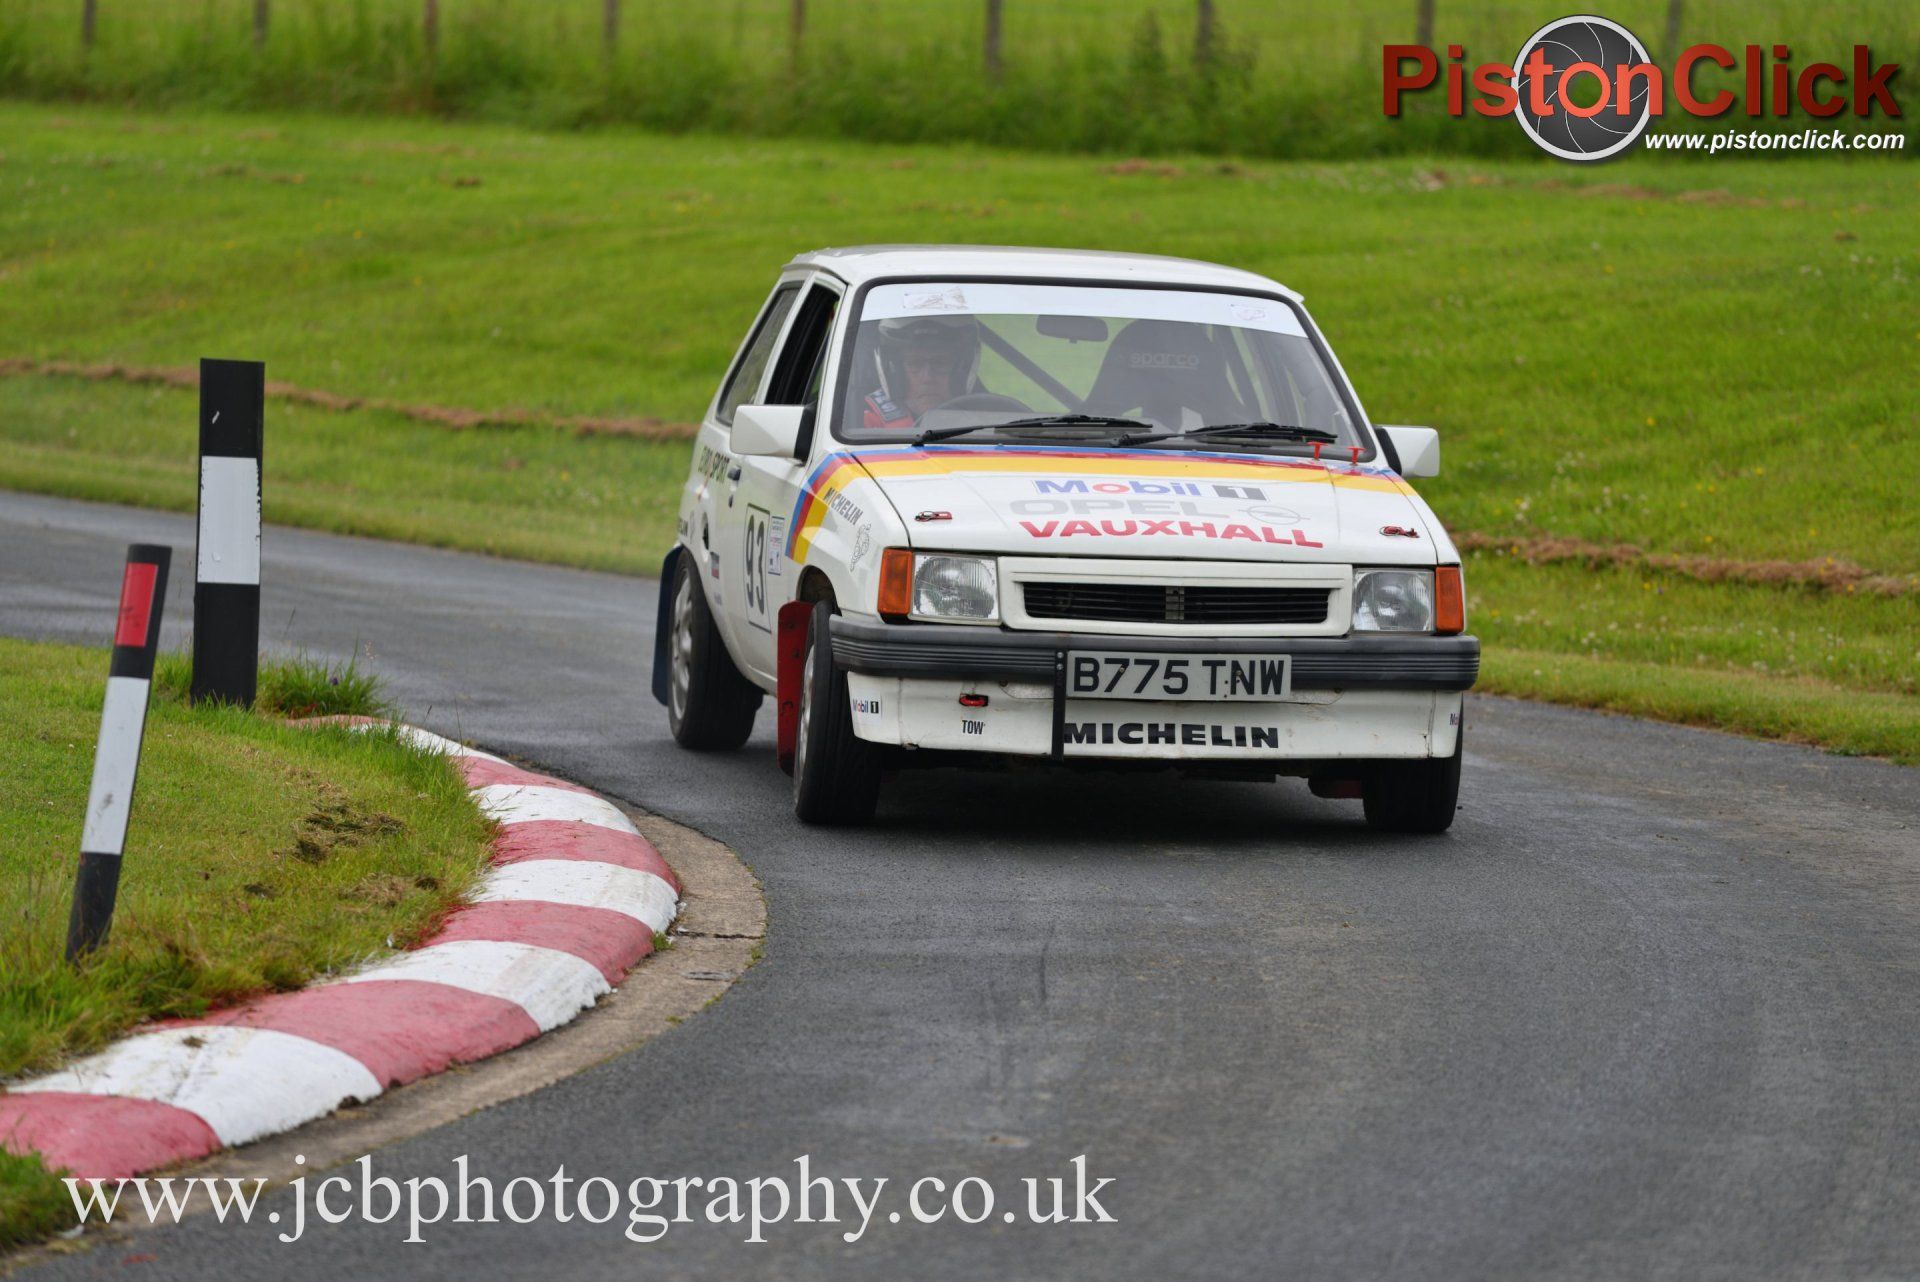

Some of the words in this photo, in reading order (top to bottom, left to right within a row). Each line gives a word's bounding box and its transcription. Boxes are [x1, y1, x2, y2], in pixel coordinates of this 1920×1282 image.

[1036, 480, 1201, 496] Mobil
[824, 487, 864, 525] MICHELIN
[1010, 499, 1230, 519] OPEL
[1018, 520, 1323, 548] VAUXHALL
[745, 515, 767, 615] 93
[1075, 658, 1189, 694] B775
[1202, 660, 1285, 695] TNW
[961, 720, 984, 734] TOW
[1064, 722, 1278, 748] MICHELIN
